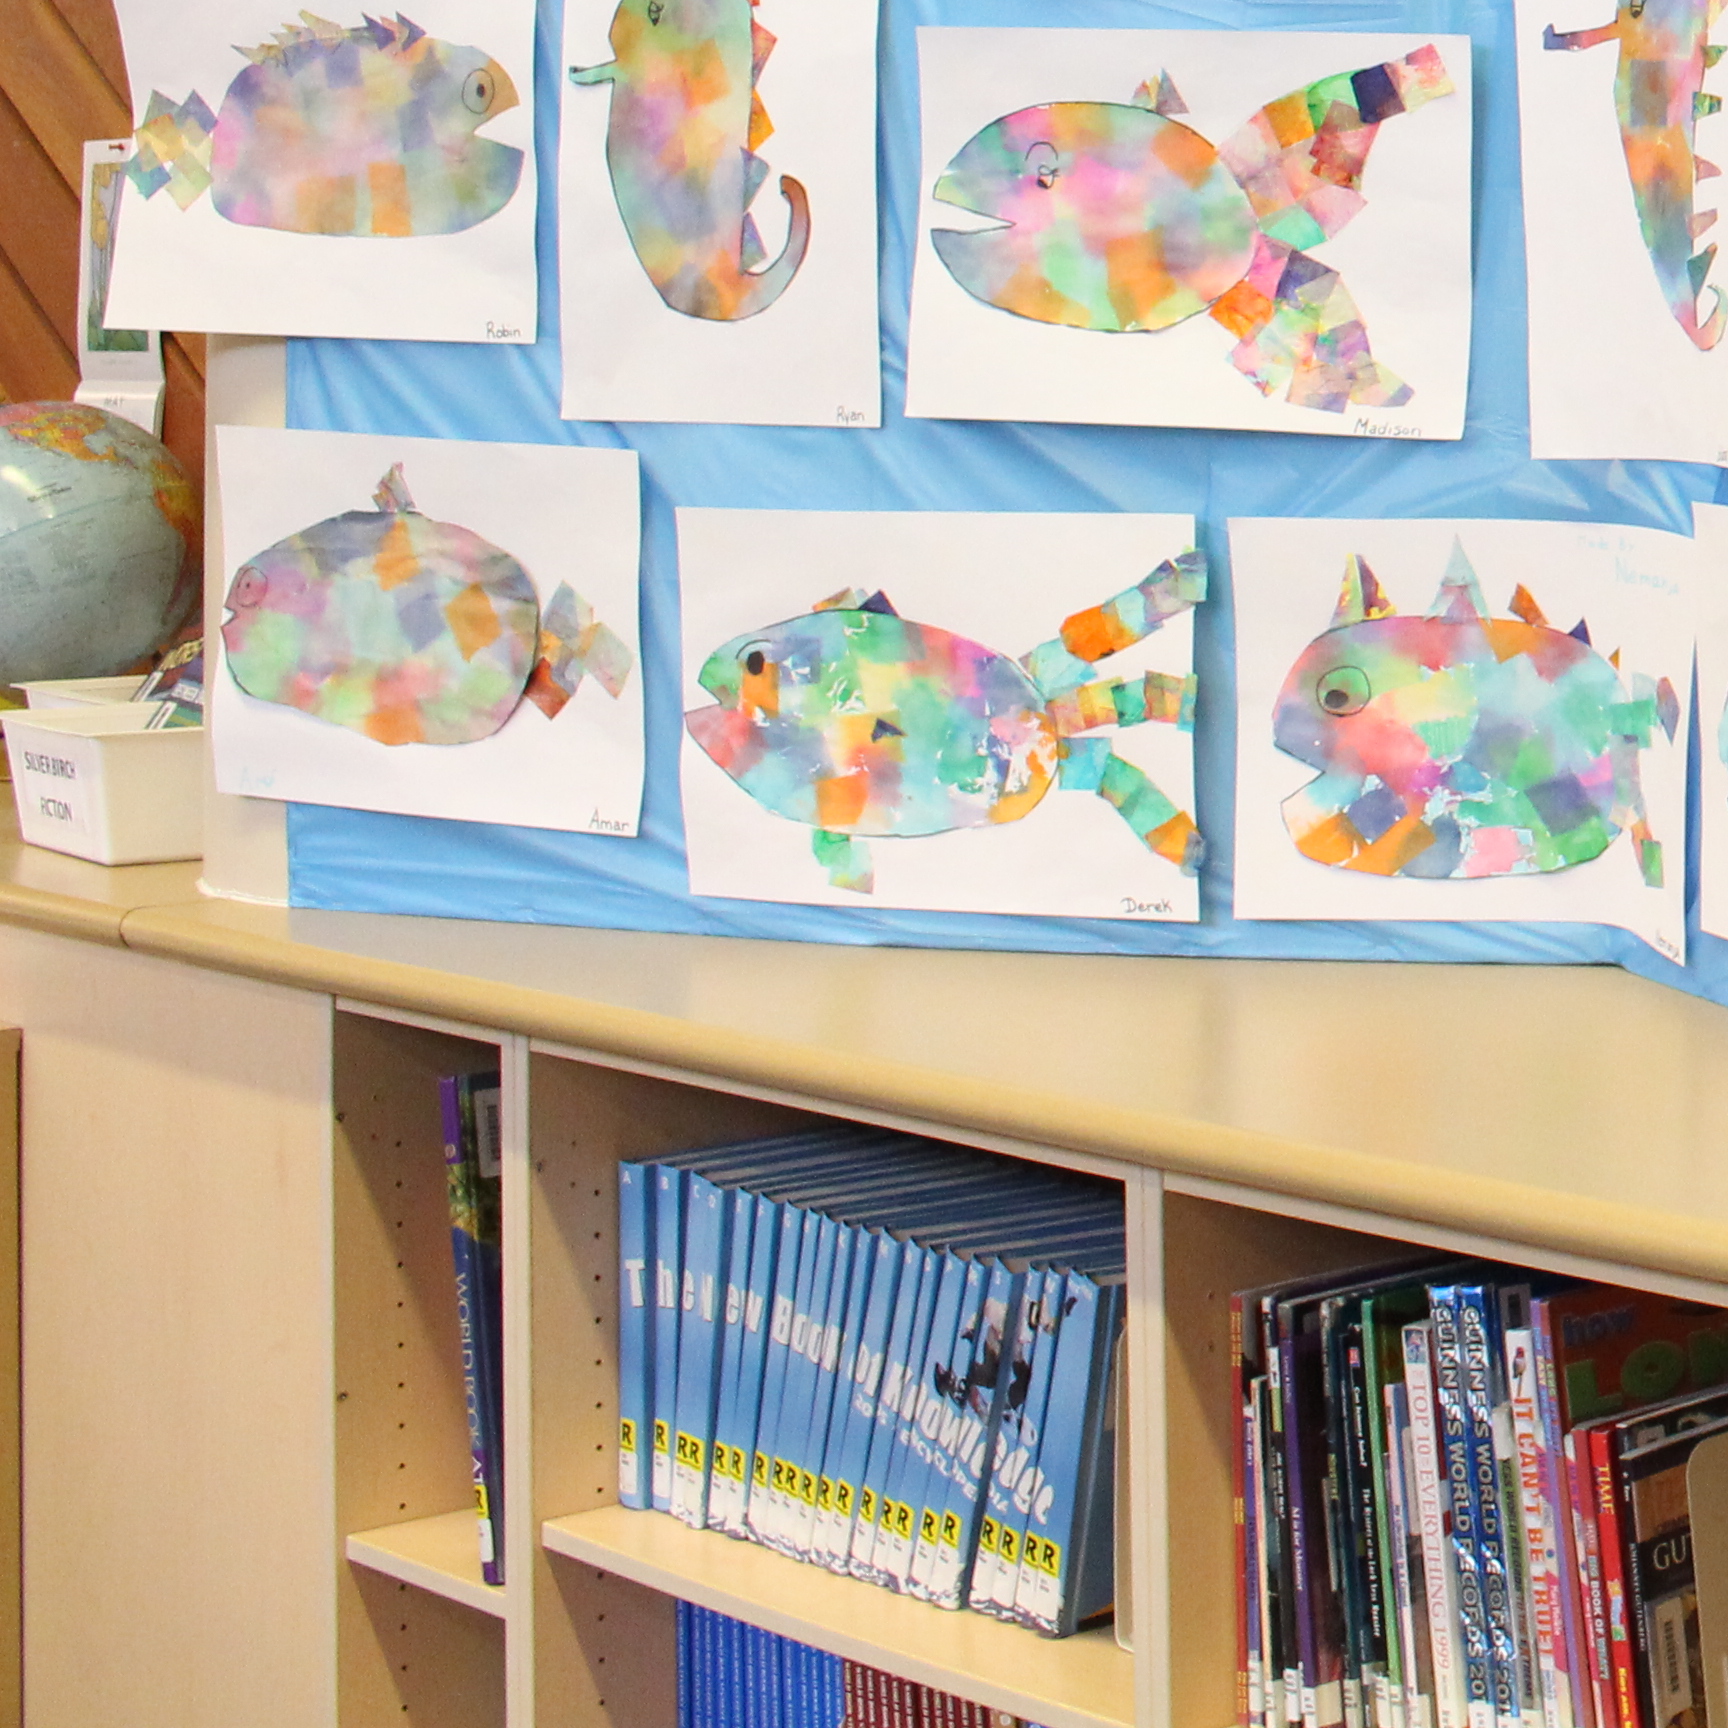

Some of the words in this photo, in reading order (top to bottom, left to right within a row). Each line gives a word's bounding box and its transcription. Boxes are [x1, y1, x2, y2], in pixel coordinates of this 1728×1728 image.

[486, 320, 522, 339] Robin
[836, 407, 865, 425] Ryan
[1353, 417, 1421, 438] Madison
[589, 808, 630, 832] Amar
[1434, 1306, 1466, 1436] GUINNESS
[1464, 1306, 1491, 1438] GUINNESS
[624, 1258, 697, 1312] The
[771, 1294, 847, 1373] Book
[882, 1360, 1055, 1525] Knowledge
[1412, 1382, 1430, 1427] TOP
[1514, 1397, 1534, 1420] IT
[622, 1423, 631, 1445] R
[655, 1424, 665, 1445] R
[1416, 1435, 1432, 1455] 10
[677, 1436, 688, 1458] R
[690, 1441, 699, 1464] R
[715, 1445, 724, 1467] R
[732, 1451, 741, 1473] R
[756, 1455, 764, 1477] R
[774, 1461, 784, 1483] R
[786, 1467, 796, 1489] R
[1517, 1433, 1542, 1516] CAN'T
[802, 1476, 811, 1498] R
[821, 1480, 829, 1503] R
[838, 1484, 849, 1506] R
[1449, 1442, 1470, 1532] WORLD
[1478, 1444, 1498, 1534] WORLD
[1596, 1464, 1615, 1514] TIME
[863, 1490, 871, 1513] R
[883, 1500, 892, 1524] R
[900, 1507, 908, 1530] R
[924, 1513, 934, 1536] R
[944, 1514, 954, 1538] R
[984, 1519, 993, 1542] R
[1002, 1530, 1013, 1555] R
[1026, 1537, 1036, 1560] R
[1419, 1470, 1447, 1618] EVERYTHING
[1527, 1528, 1544, 1562] BE
[1043, 1544, 1054, 1568] R
[1294, 1549, 1304, 1591] Monster
[1458, 1538, 1484, 1658] RECORDS
[1481, 1541, 1508, 1662] RECORDS
[1590, 1581, 1602, 1616] BOOK
[1594, 1618, 1604, 1635] OF
[1434, 1627, 1451, 1669] 1999
